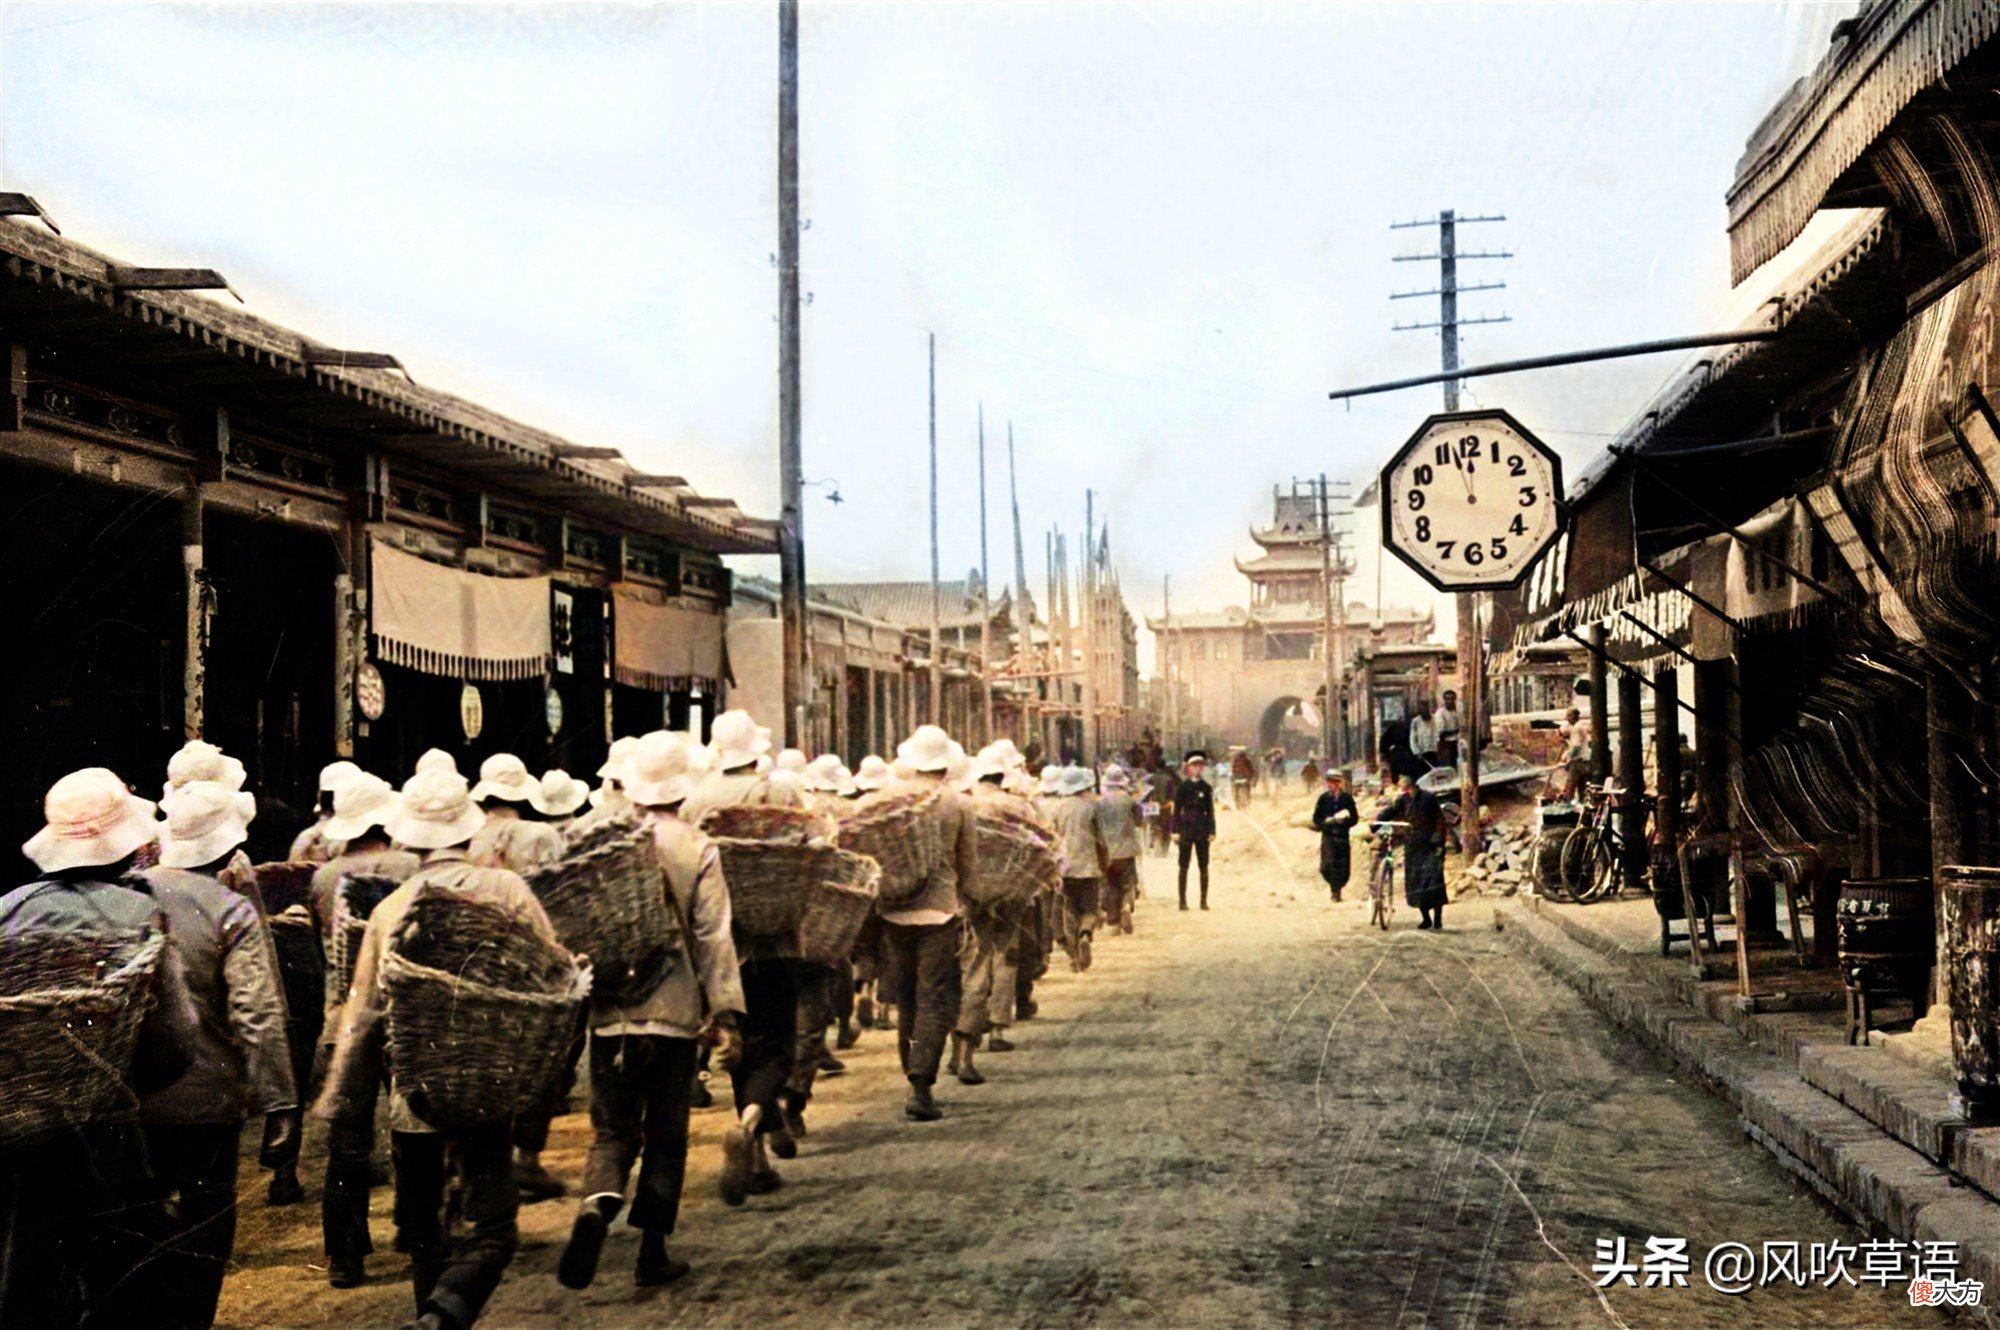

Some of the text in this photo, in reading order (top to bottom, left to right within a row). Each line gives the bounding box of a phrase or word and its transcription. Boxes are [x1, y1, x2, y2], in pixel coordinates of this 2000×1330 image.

[1436, 442, 1450, 466] 11
[1458, 435, 1481, 459] 12
[1490, 441, 1500, 464] 1
[1413, 464, 1433, 486] 10
[1507, 455, 1527, 477] 2
[1408, 489, 1426, 511] 9
[1518, 486, 1537, 508] 3
[1415, 515, 1431, 543] 8
[1508, 512, 1529, 536] 4
[1436, 541, 1457, 560] 7
[1464, 542, 1484, 566] 6
[1490, 537, 1508, 560] 5
